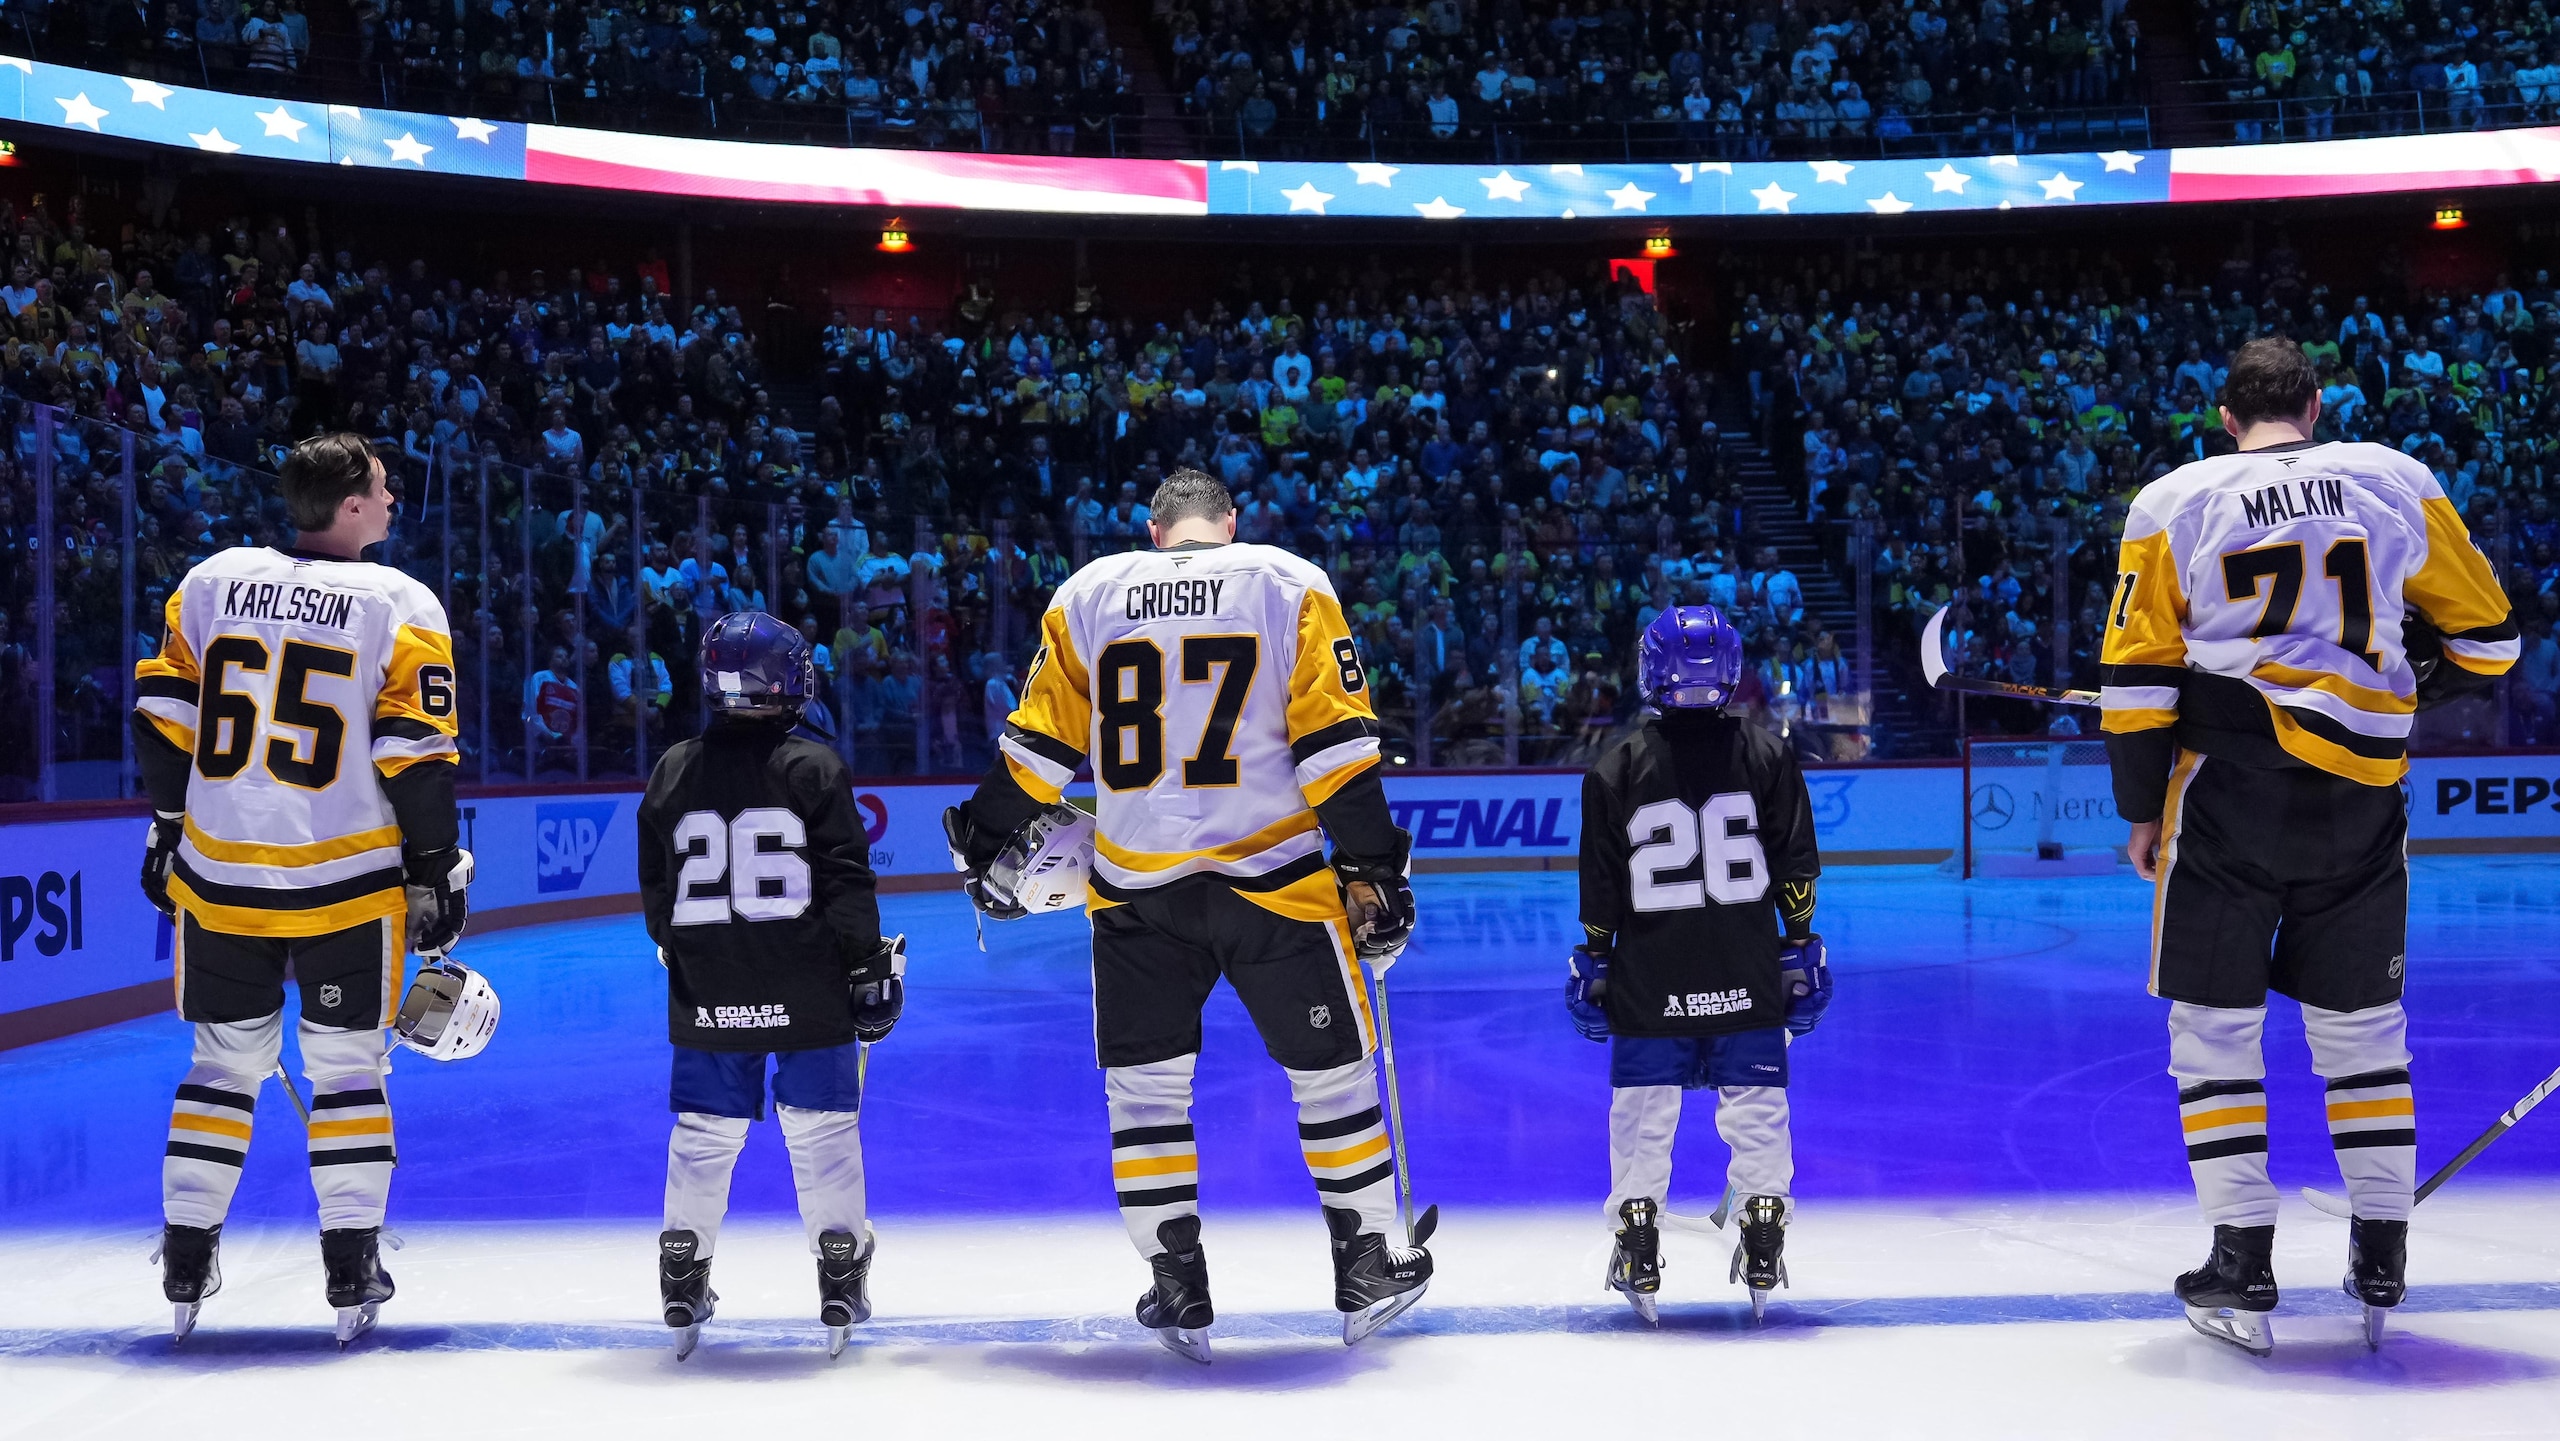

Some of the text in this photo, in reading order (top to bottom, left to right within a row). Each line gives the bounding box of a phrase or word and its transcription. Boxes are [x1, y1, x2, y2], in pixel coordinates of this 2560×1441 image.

[2240, 480, 2346, 528] MALKIN
[223, 581, 354, 629] KARLSSON
[1126, 579, 1224, 620] CROSBY
[2220, 537, 2387, 676] 71
[416, 663, 454, 718] 6
[1331, 635, 1367, 695] 8
[2001, 683, 2048, 697] TACKS
[197, 634, 358, 792] 65
[1097, 634, 1260, 793] 87
[538, 817, 598, 877] SAP
[1388, 797, 1571, 848] TENAL
[671, 807, 812, 926] 26
[1626, 791, 1771, 912] 26
[0, 869, 83, 962] PSI
[1044, 893, 1067, 908] 87
[716, 1014, 790, 1029] DREAMS
[1686, 998, 1752, 1016] DREAMS
[664, 1240, 692, 1248] CCM
[1394, 1270, 1416, 1279] CCM
